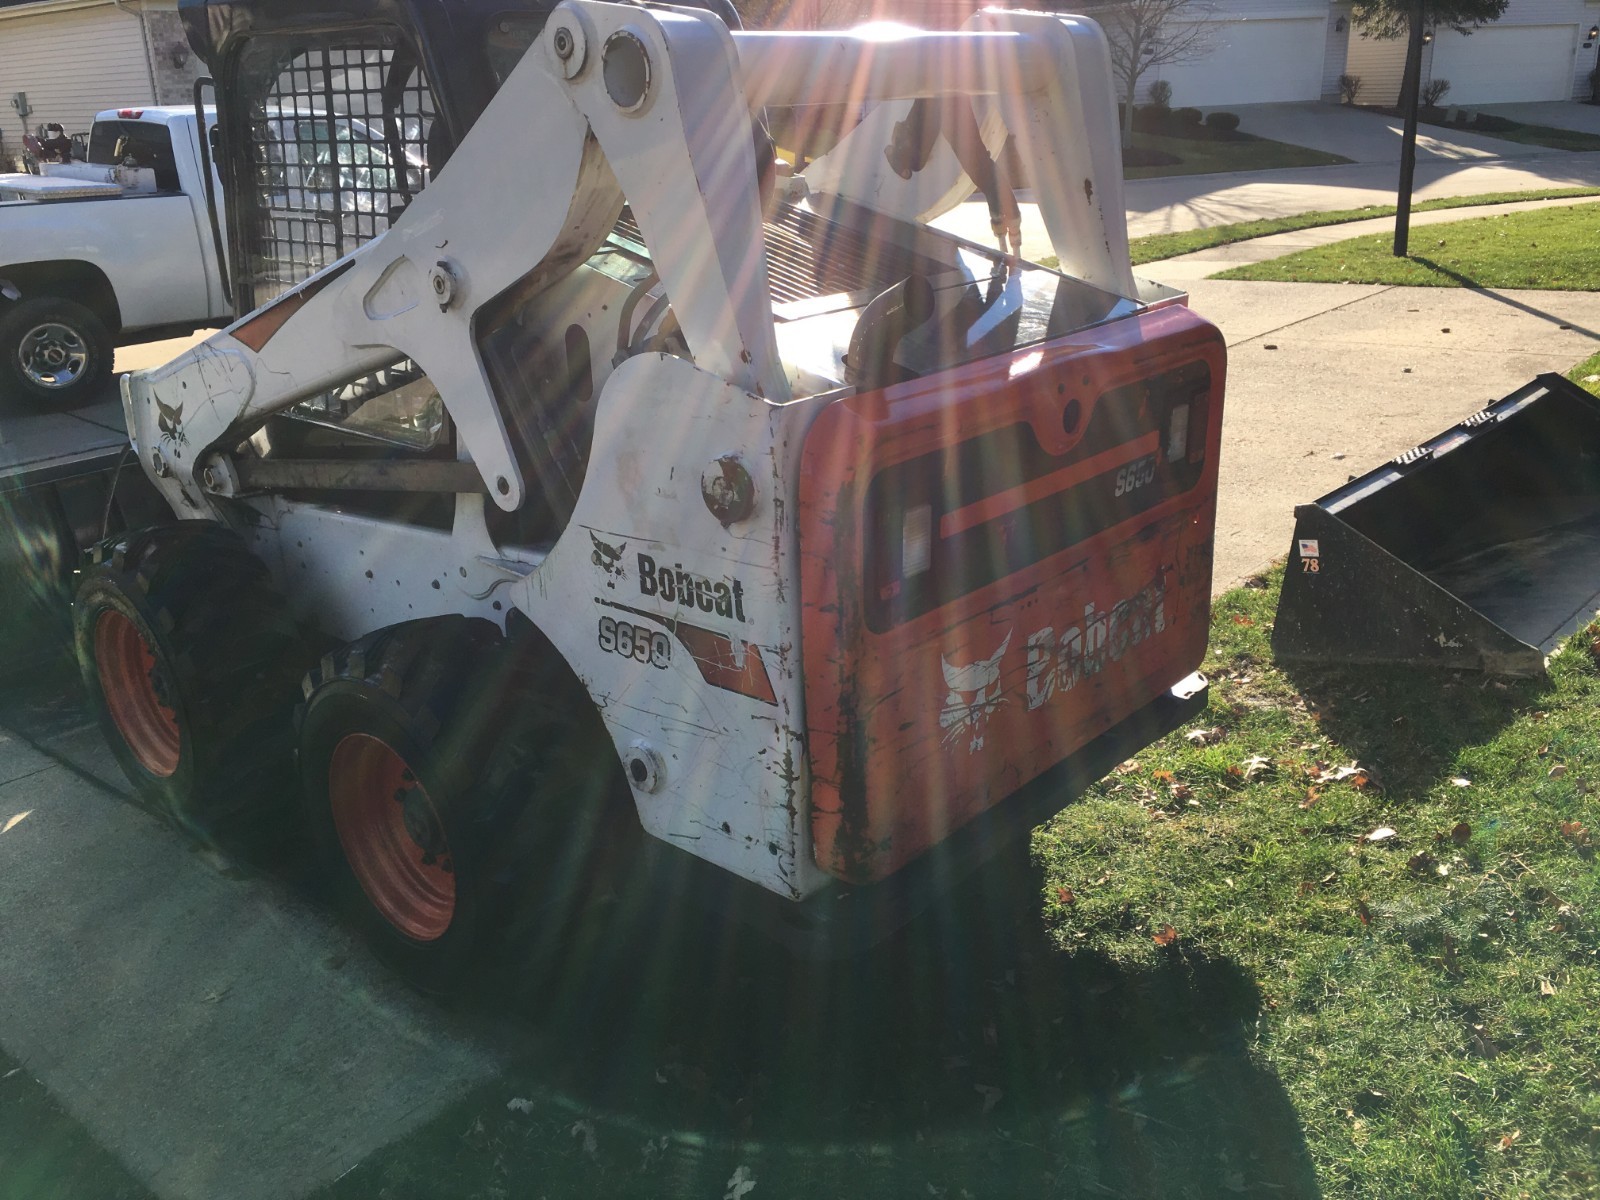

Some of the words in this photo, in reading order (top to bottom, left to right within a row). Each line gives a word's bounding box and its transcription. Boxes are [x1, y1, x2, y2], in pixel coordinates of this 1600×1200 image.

[637, 552, 746, 624] Bobcat
[1301, 558, 1320, 572] 78
[599, 615, 672, 670] S650
